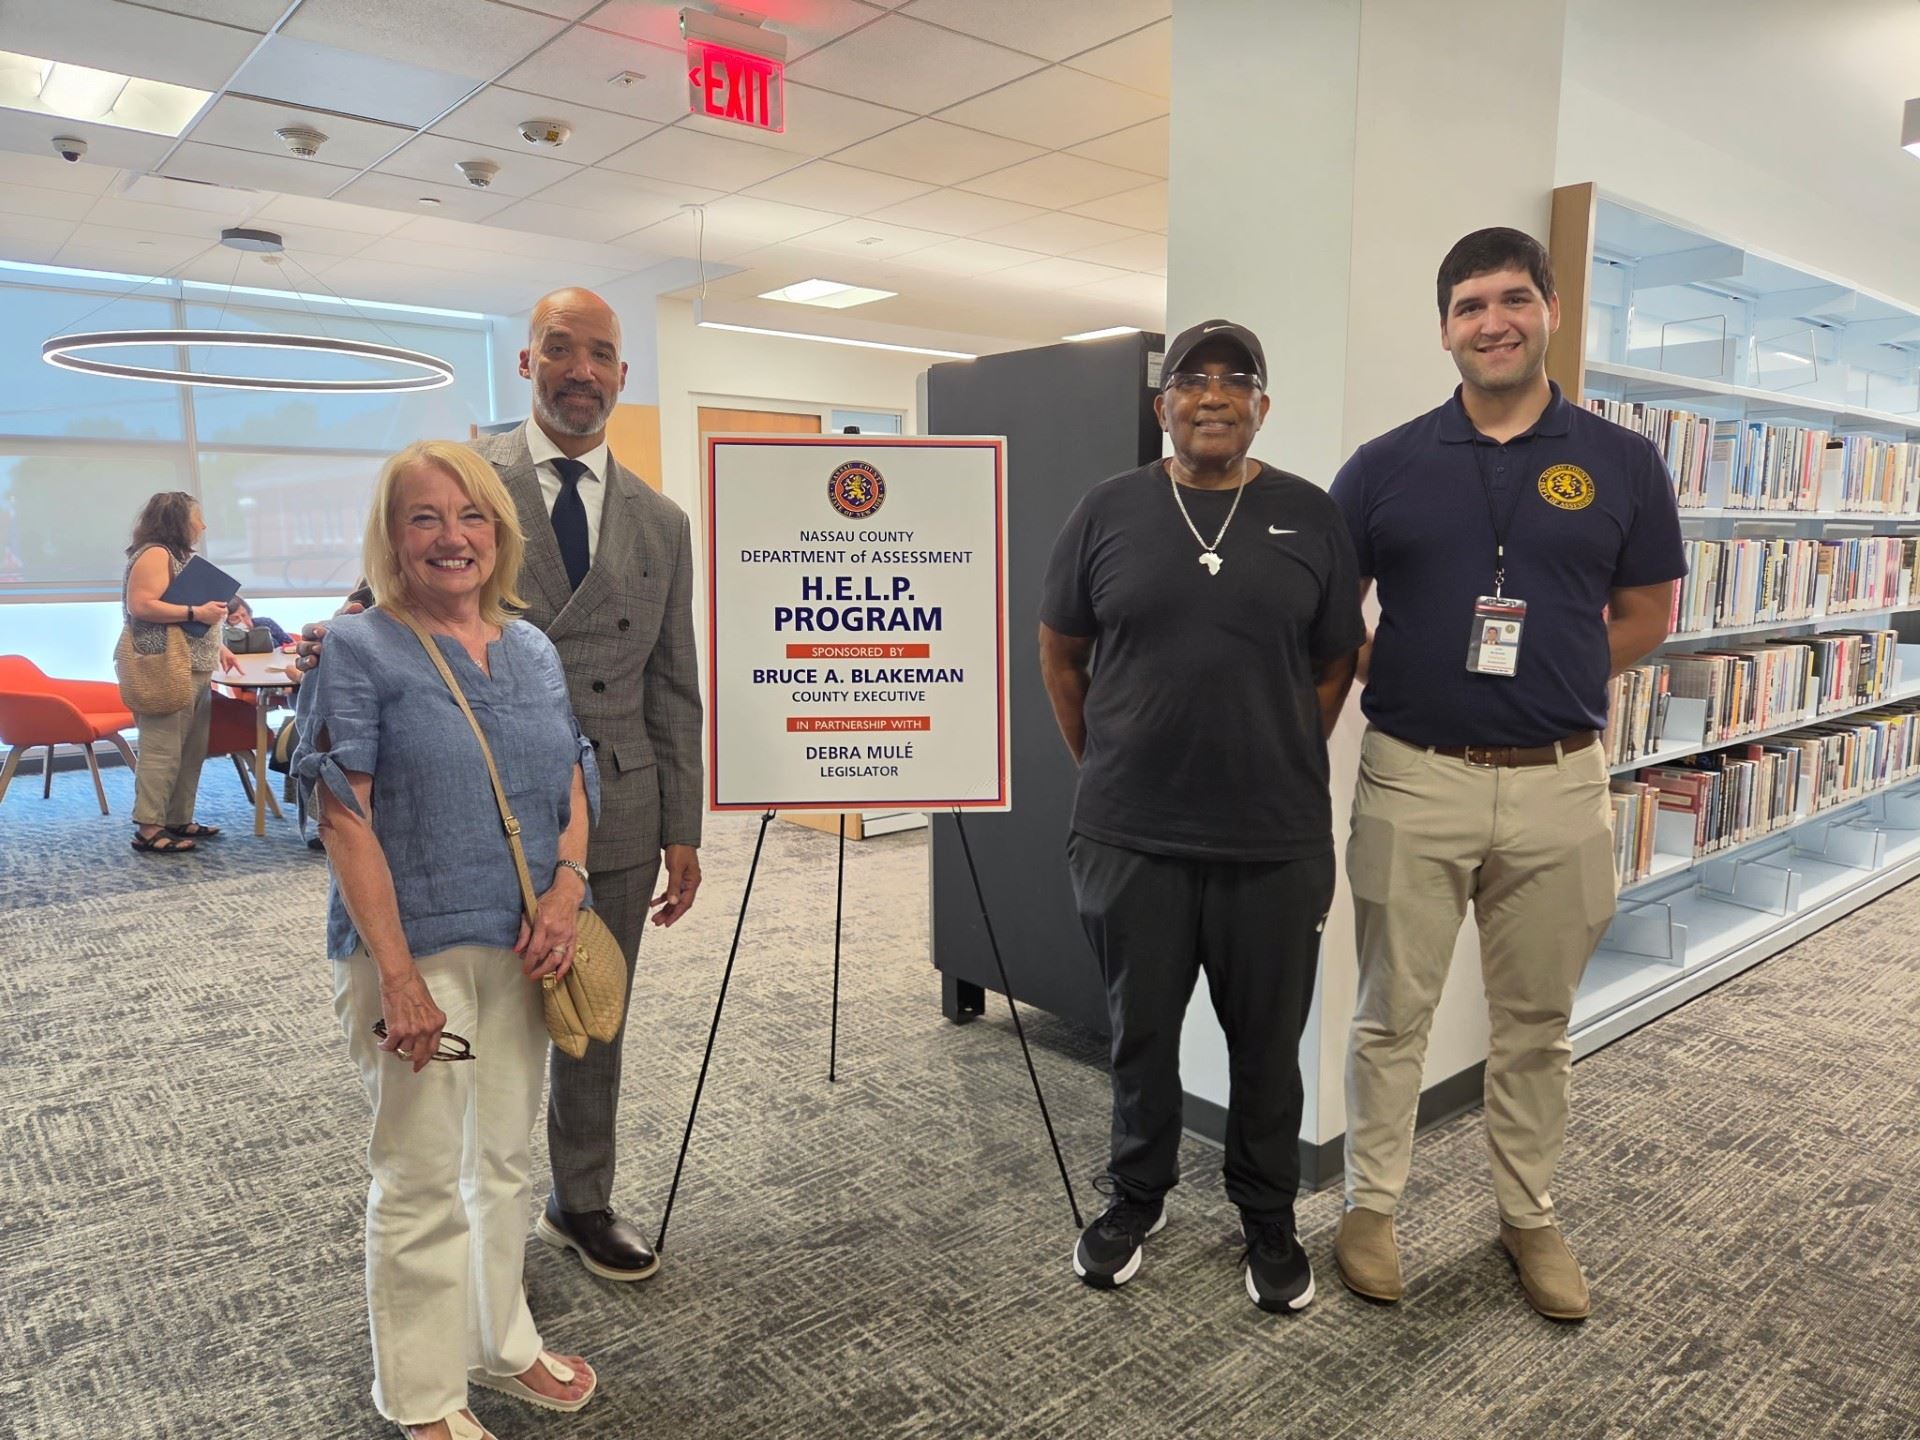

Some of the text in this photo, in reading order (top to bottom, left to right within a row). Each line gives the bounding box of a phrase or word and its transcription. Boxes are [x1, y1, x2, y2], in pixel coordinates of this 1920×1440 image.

[703, 49, 773, 126] EXIT
[799, 530, 914, 543] NASSAU COUNTY
[740, 549, 973, 564] DEPARTMENT of ASSESSMENT
[801, 576, 915, 601] H.E.L.P.
[774, 606, 942, 632] PROGRAM
[811, 646, 905, 658] SPONSORED BY
[752, 668, 964, 685] BRUCE A. BLAKEMAN
[791, 690, 926, 703] COUNTY EXECUTIVE
[795, 719, 922, 731] IN PARTNERSHIP WITH
[805, 741, 914, 761] DEBRA MULÉ
[820, 766, 899, 778] LEGISLATOR
